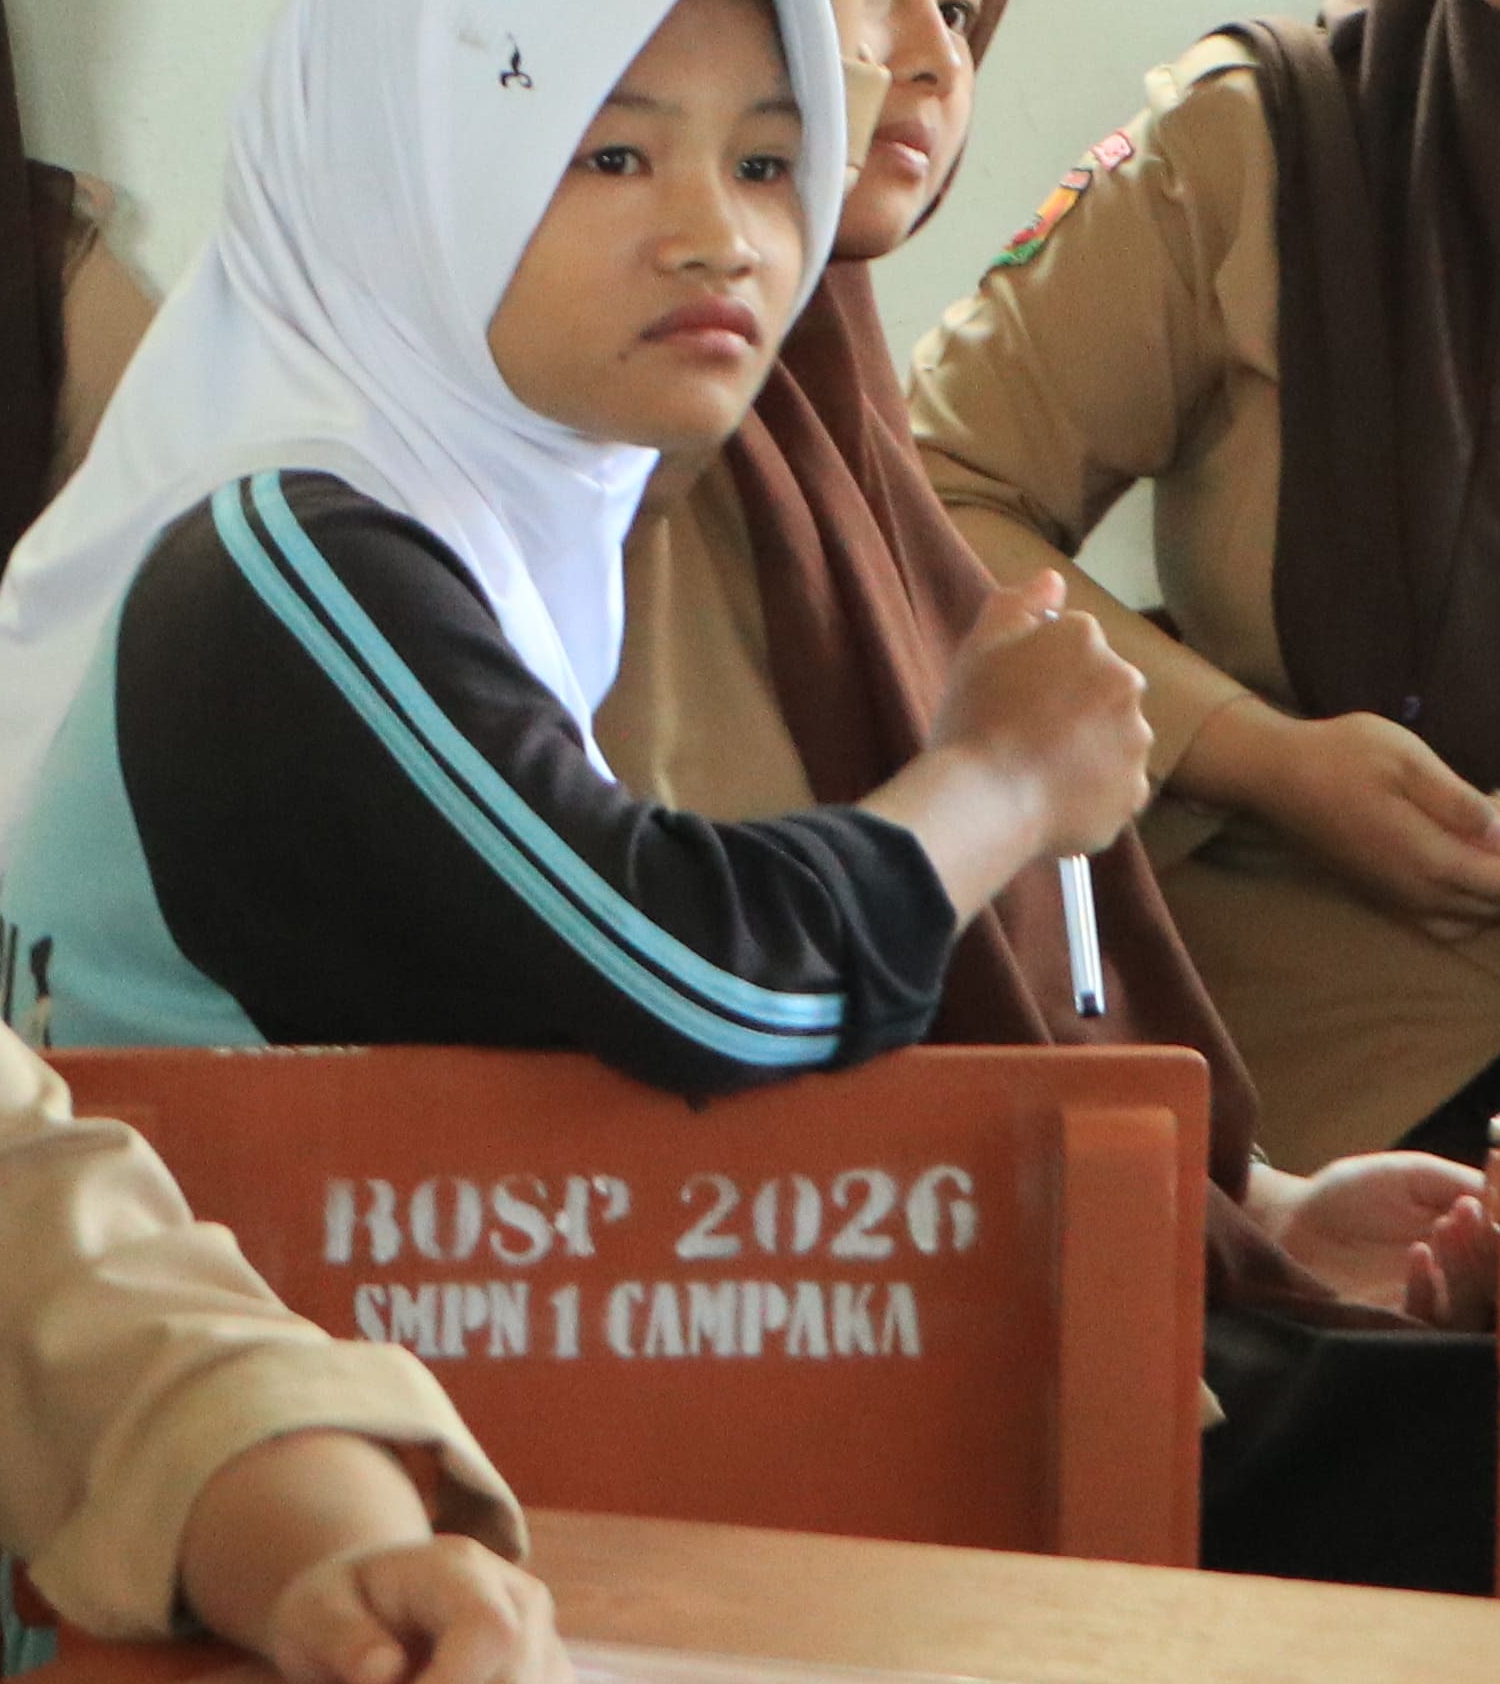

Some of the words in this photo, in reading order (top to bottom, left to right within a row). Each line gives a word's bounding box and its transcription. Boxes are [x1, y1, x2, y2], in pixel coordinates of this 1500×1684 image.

[674, 1164, 980, 1261] 2026
[354, 1281, 530, 1359] SMPN
[550, 1282, 582, 1359] 1
[603, 1279, 922, 1359] CAMPAKA
